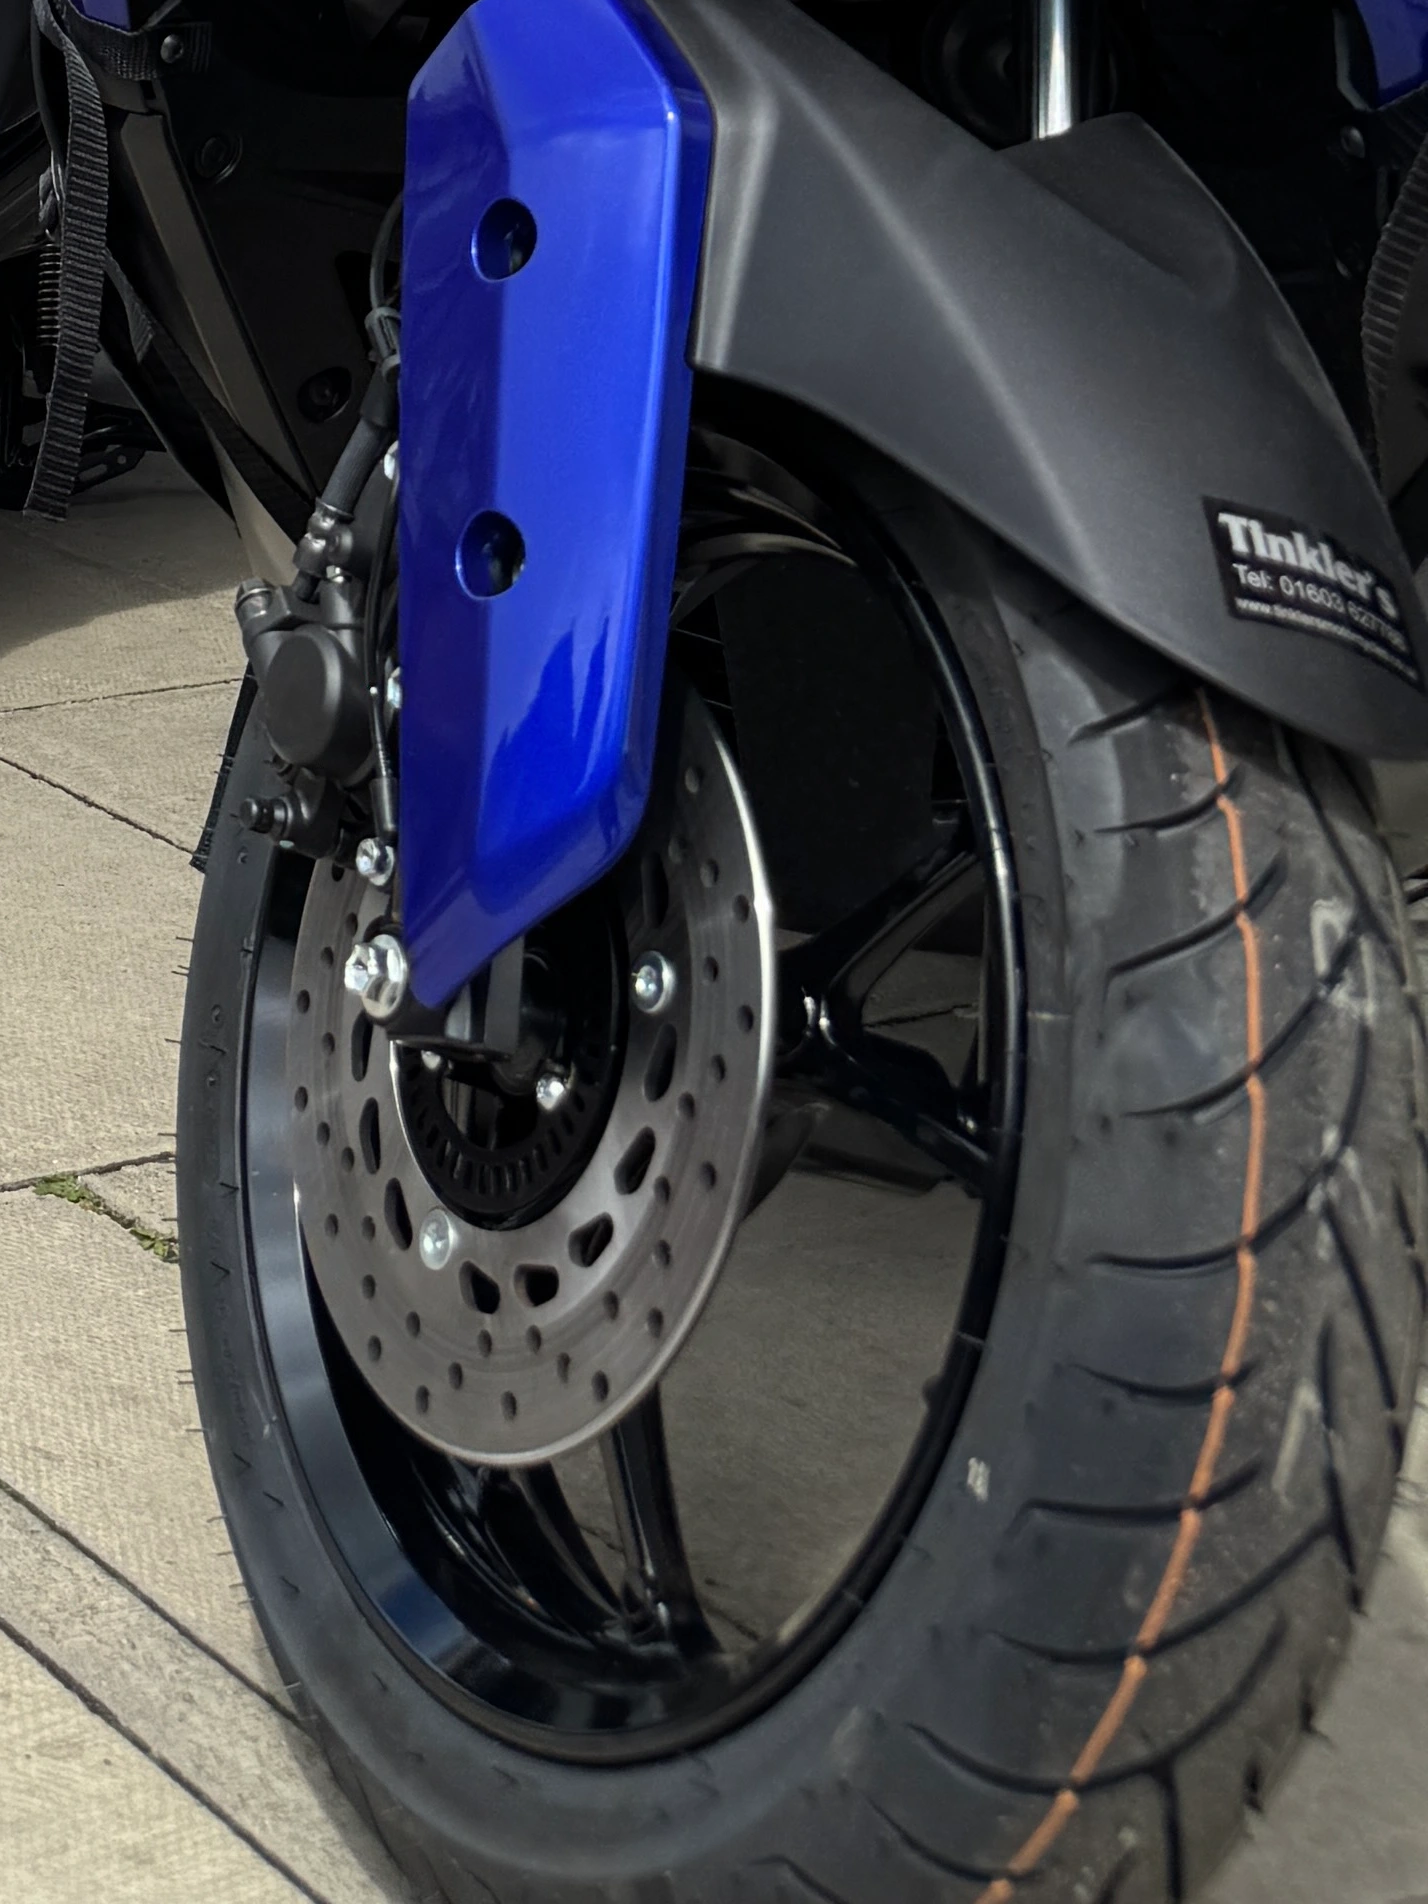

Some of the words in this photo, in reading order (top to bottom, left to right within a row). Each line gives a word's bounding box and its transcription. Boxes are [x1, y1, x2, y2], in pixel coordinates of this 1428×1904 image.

[1218, 512, 1399, 619] Tinkler's
[1232, 562, 1274, 590] Tel:
[1278, 574, 1346, 615] 01603
